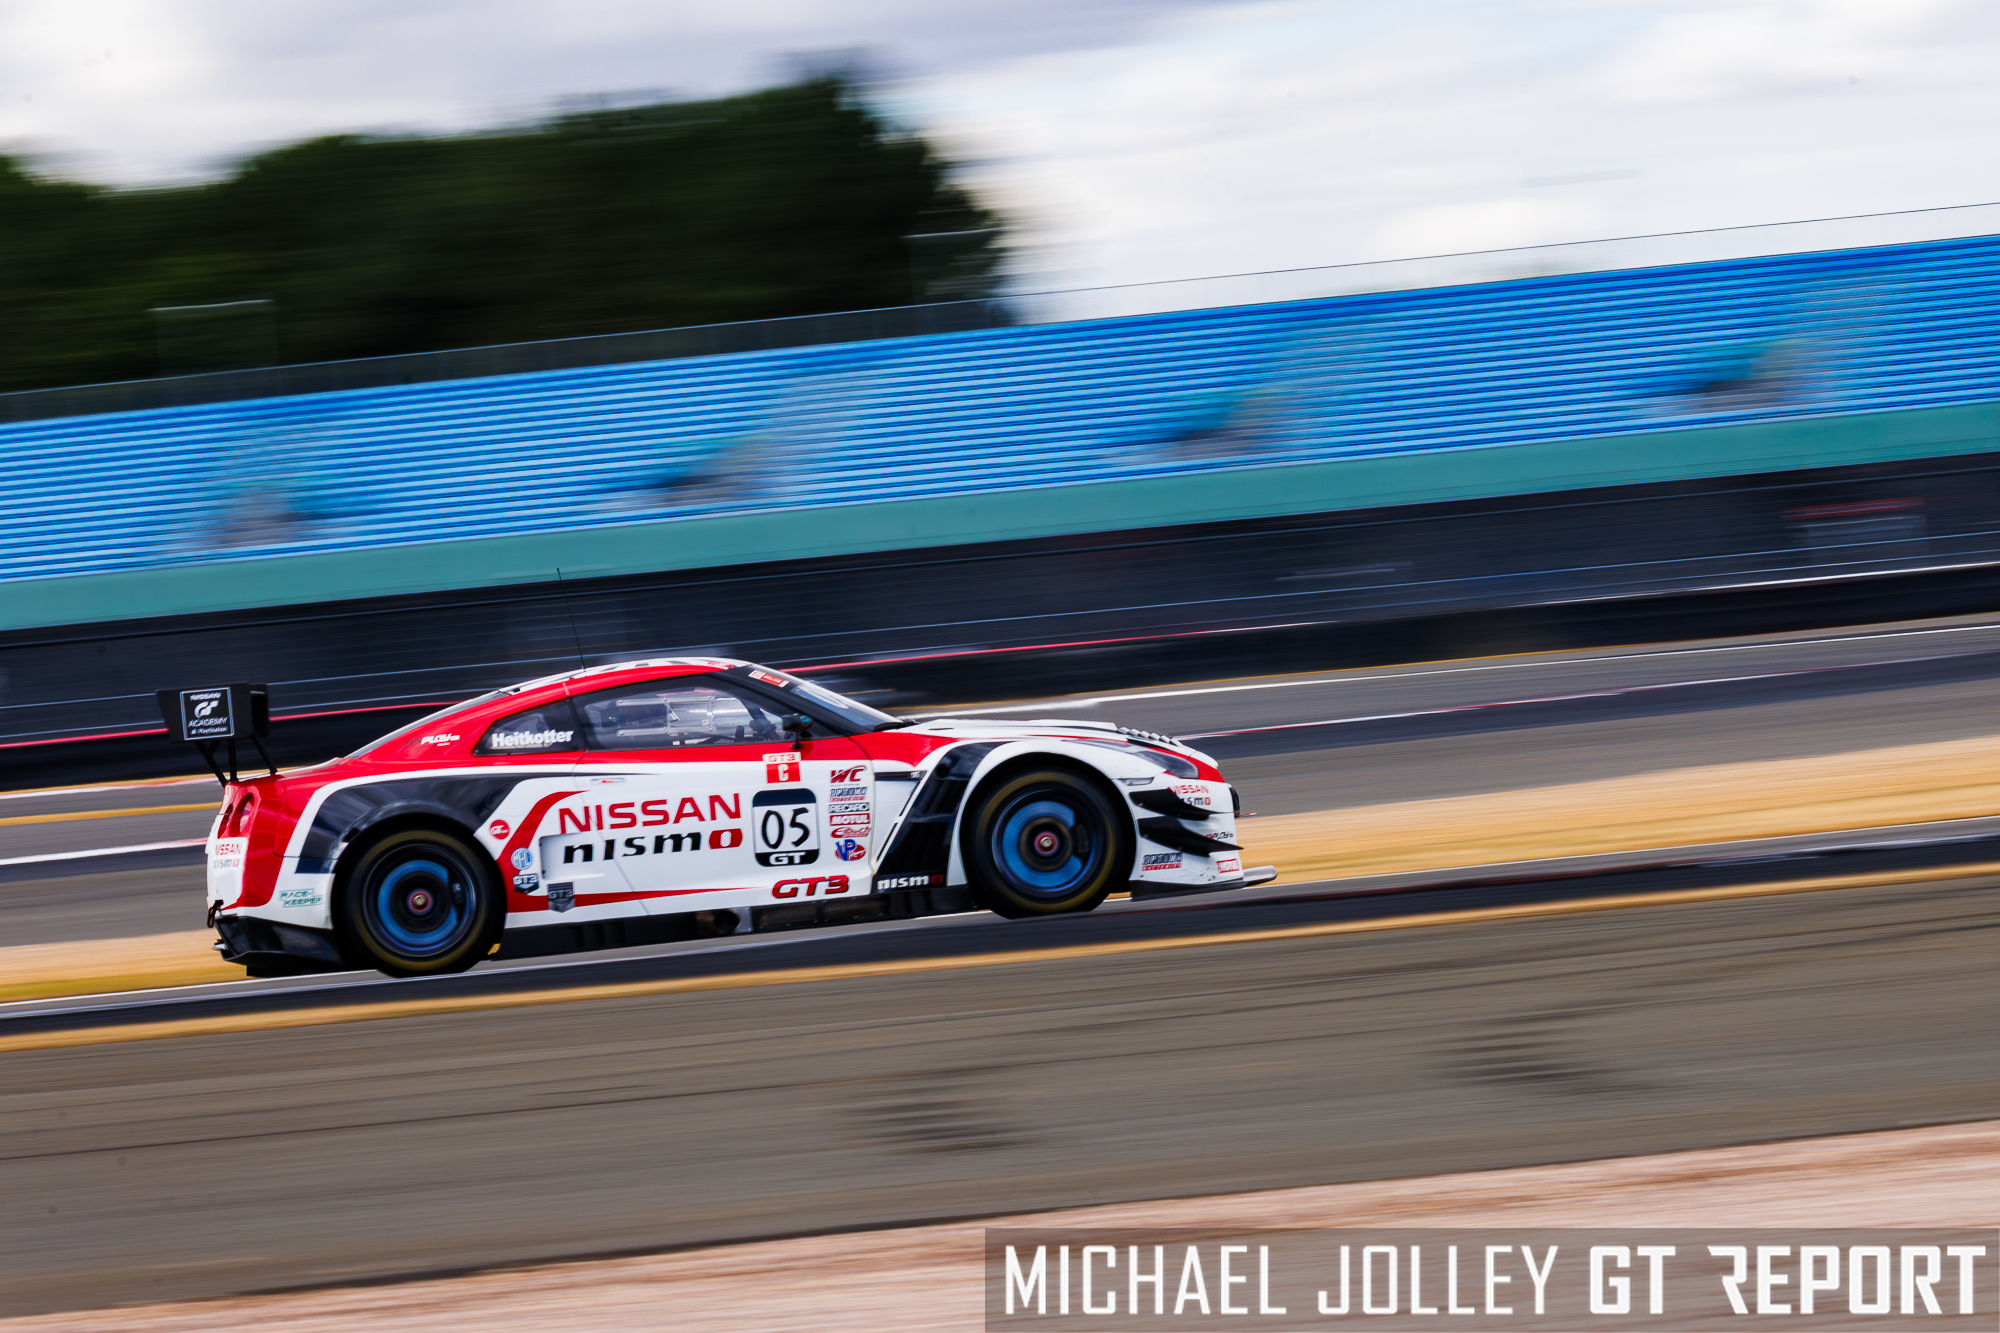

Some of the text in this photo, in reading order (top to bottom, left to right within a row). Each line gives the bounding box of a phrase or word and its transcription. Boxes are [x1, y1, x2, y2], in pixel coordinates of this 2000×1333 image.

[188, 717, 228, 727] ACADEMY
[491, 729, 574, 747] Heitkotter
[769, 754, 796, 762] GT3
[778, 764, 788, 781] C
[559, 793, 742, 834] NISSAN
[830, 803, 869, 812] RECARO
[831, 814, 870, 824] MOTUL
[761, 807, 810, 849] 05
[563, 828, 743, 864] nismo
[769, 852, 806, 865] GT
[513, 875, 538, 885] GT3
[772, 875, 849, 899] GT3
[877, 875, 944, 890] nismo
[548, 890, 573, 899] GT3
